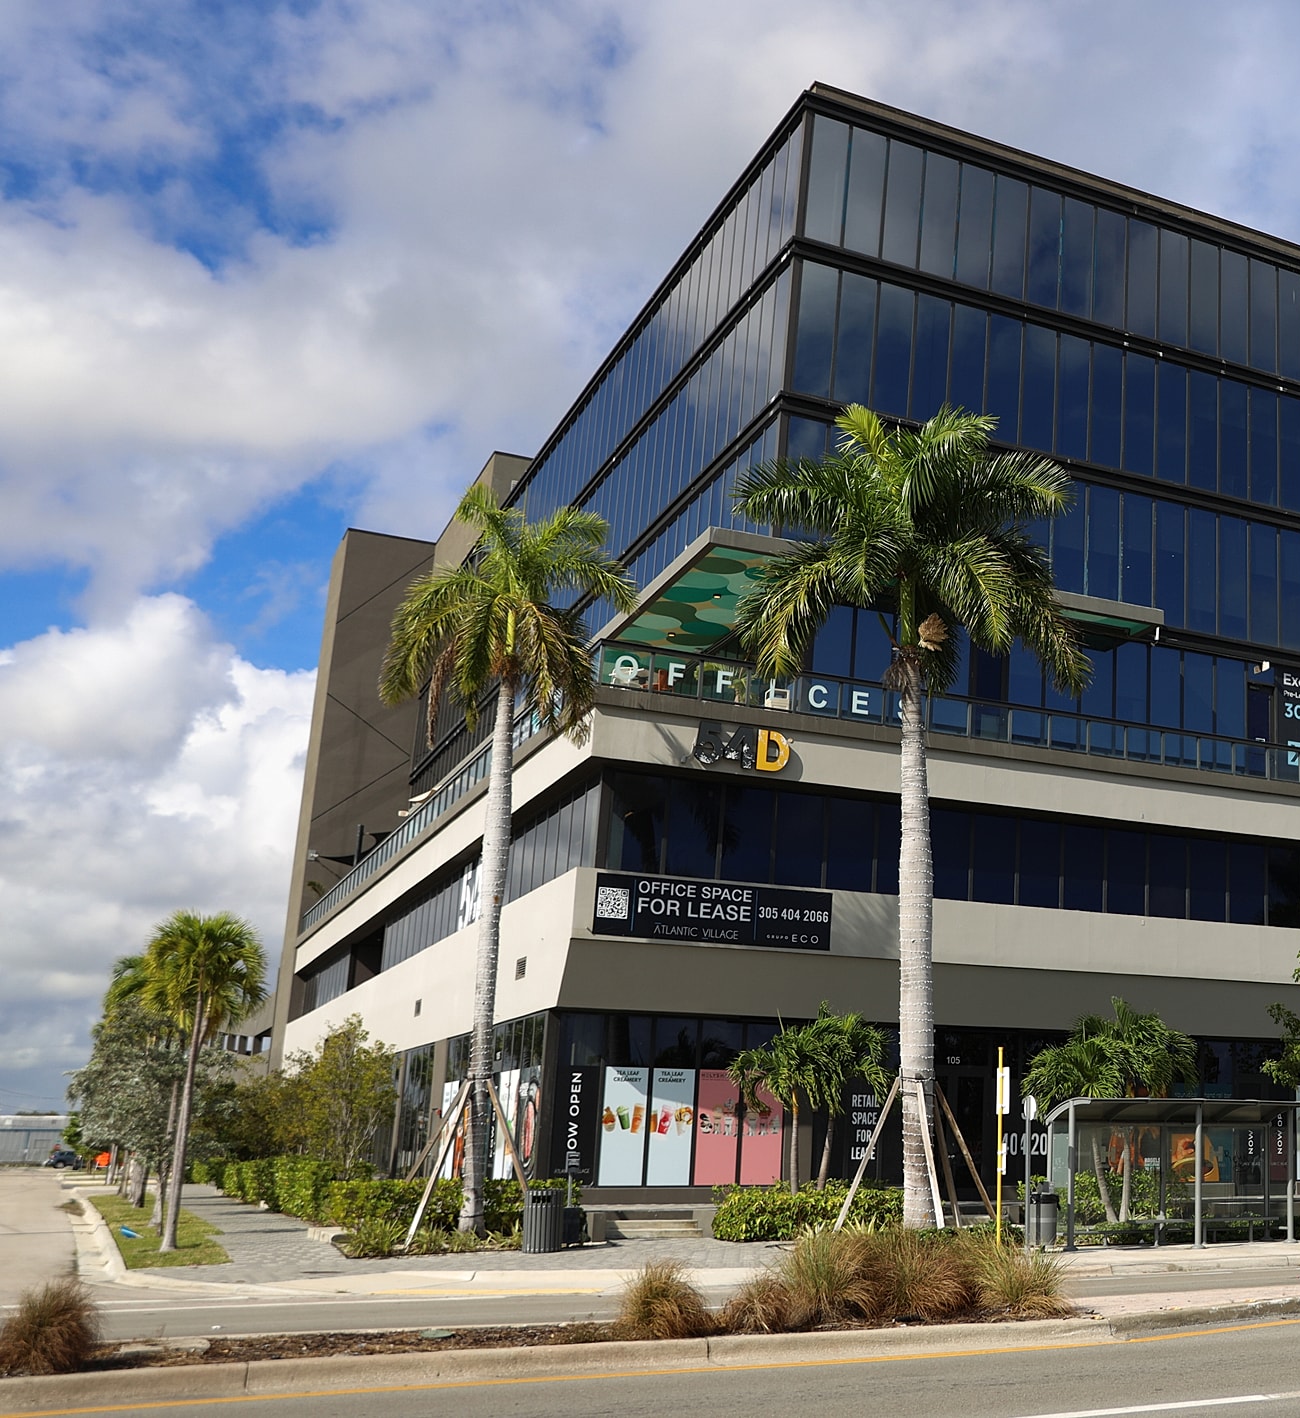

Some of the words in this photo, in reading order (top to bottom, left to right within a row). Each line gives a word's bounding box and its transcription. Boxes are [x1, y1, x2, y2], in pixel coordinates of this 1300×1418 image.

[694, 721, 792, 772] 54D
[638, 880, 697, 898] OFFICE
[701, 886, 753, 903] SPACE
[637, 897, 680, 916] FOR
[687, 903, 752, 922] LEASE
[758, 906, 779, 919] 305
[780, 908, 800, 921] 404
[803, 908, 829, 923] 2066
[653, 923, 698, 937] ATLANTIC
[702, 929, 739, 940] VILLAGE
[791, 934, 819, 944] ECO
[946, 1056, 961, 1065] 105
[569, 1072, 583, 1117] OPEN
[851, 1094, 880, 1108] RETAIL
[851, 1112, 878, 1125] SPACE
[856, 1129, 872, 1143] FOR
[851, 1146, 876, 1160] LEAE
